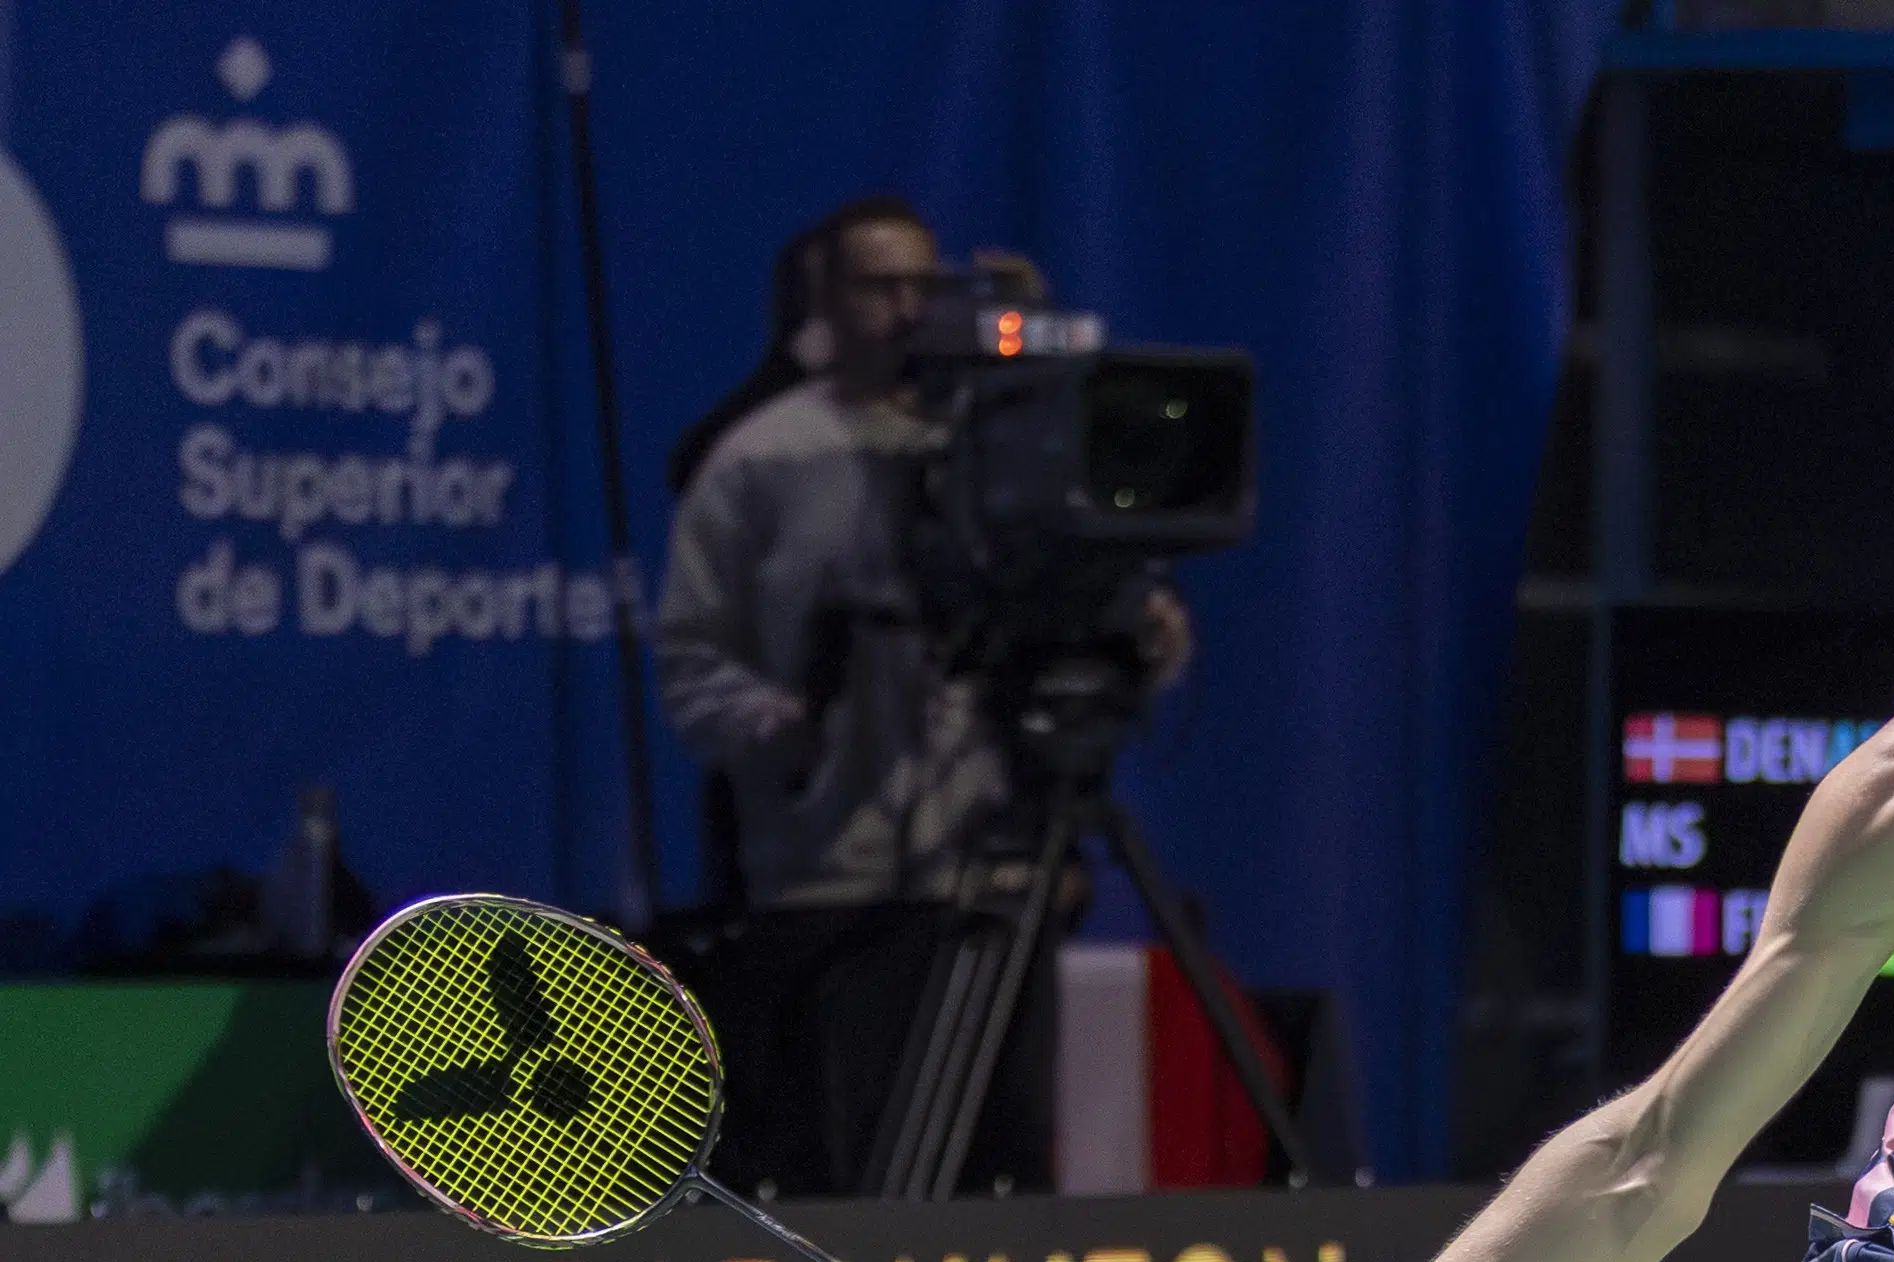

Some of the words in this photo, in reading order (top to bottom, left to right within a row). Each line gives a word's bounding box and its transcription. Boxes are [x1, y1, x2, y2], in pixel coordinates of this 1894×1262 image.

[170, 312, 495, 434] Consejo
[180, 422, 514, 541] Superior
[176, 536, 282, 635] de
[299, 541, 650, 655] Deporte
[1725, 717, 1829, 783] DEN
[1620, 801, 1706, 868] MS
